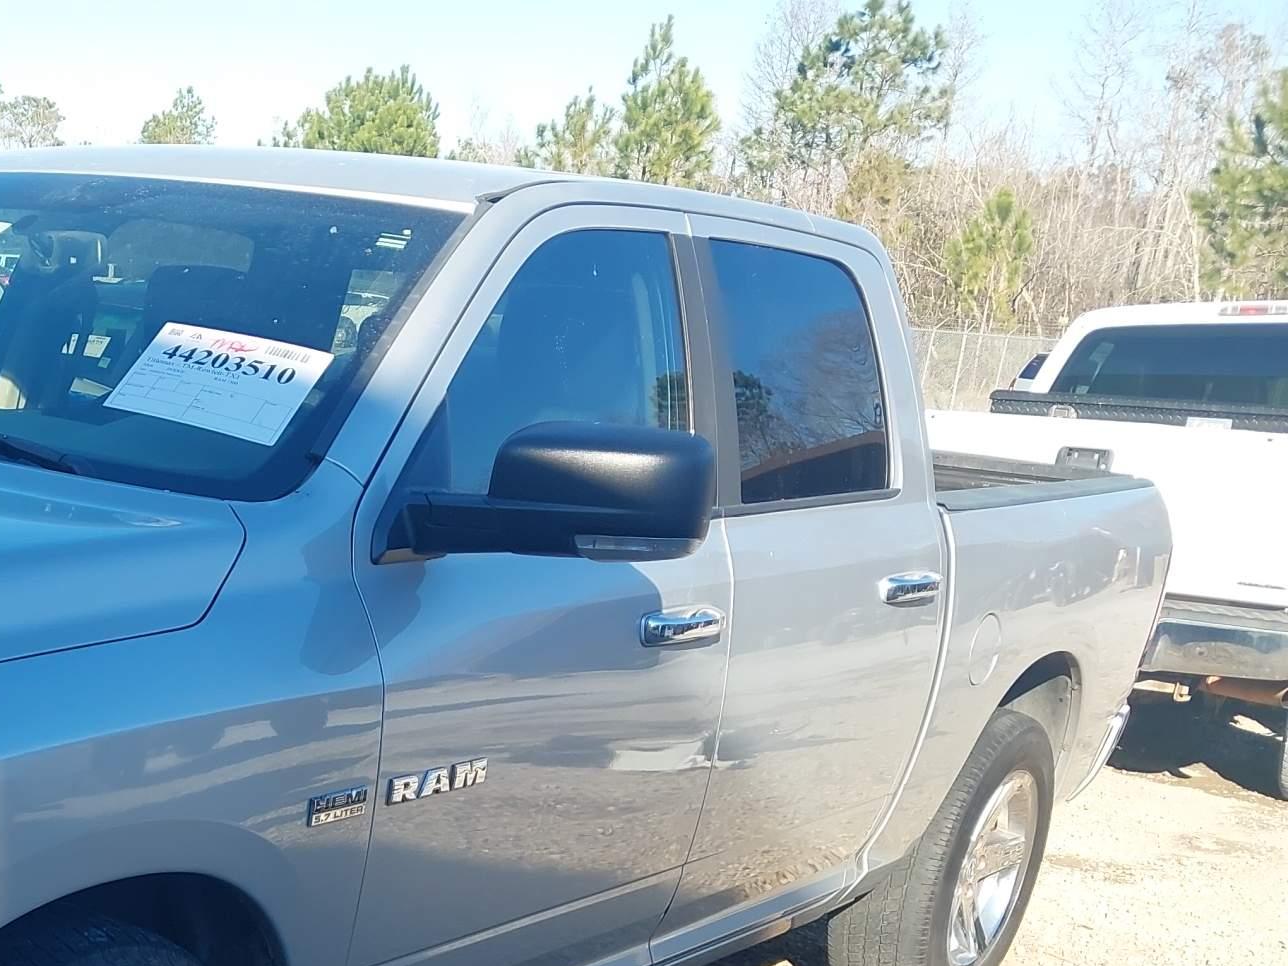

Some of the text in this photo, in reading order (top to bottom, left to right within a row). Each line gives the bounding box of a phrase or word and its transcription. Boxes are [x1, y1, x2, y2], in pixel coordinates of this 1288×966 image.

[162, 344, 296, 385] 44203510
[385, 757, 488, 806] RAM
[312, 785, 368, 813] HEMI
[313, 804, 365, 825] 5.7 LITER
